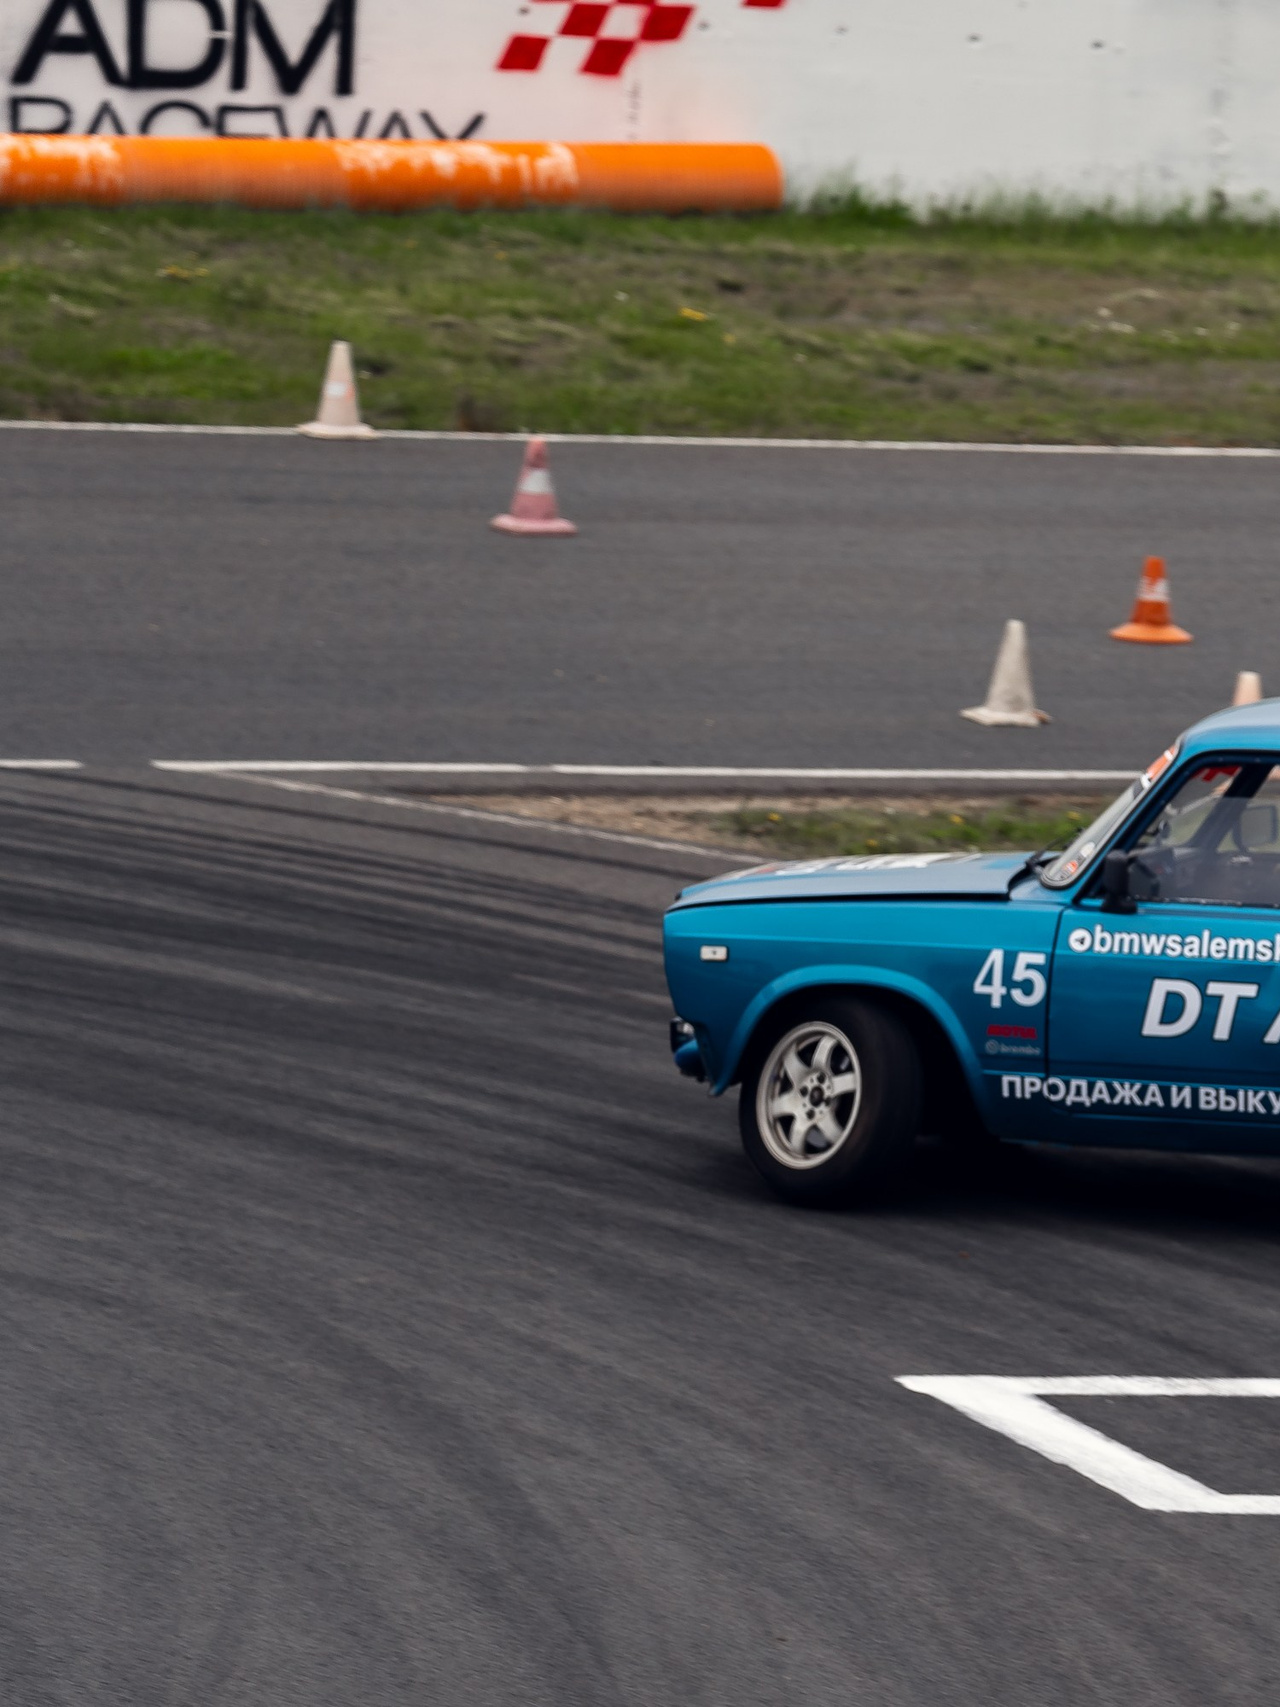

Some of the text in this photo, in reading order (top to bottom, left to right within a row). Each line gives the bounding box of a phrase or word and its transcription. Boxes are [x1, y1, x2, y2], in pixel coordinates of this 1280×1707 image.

[11, 0, 355, 96] ADM
[973, 948, 1047, 1008] 45
[1141, 978, 1259, 1041] DT
[1001, 1075, 1164, 1107] ПРОДАЖА
[1170, 1084, 1192, 1109] И
